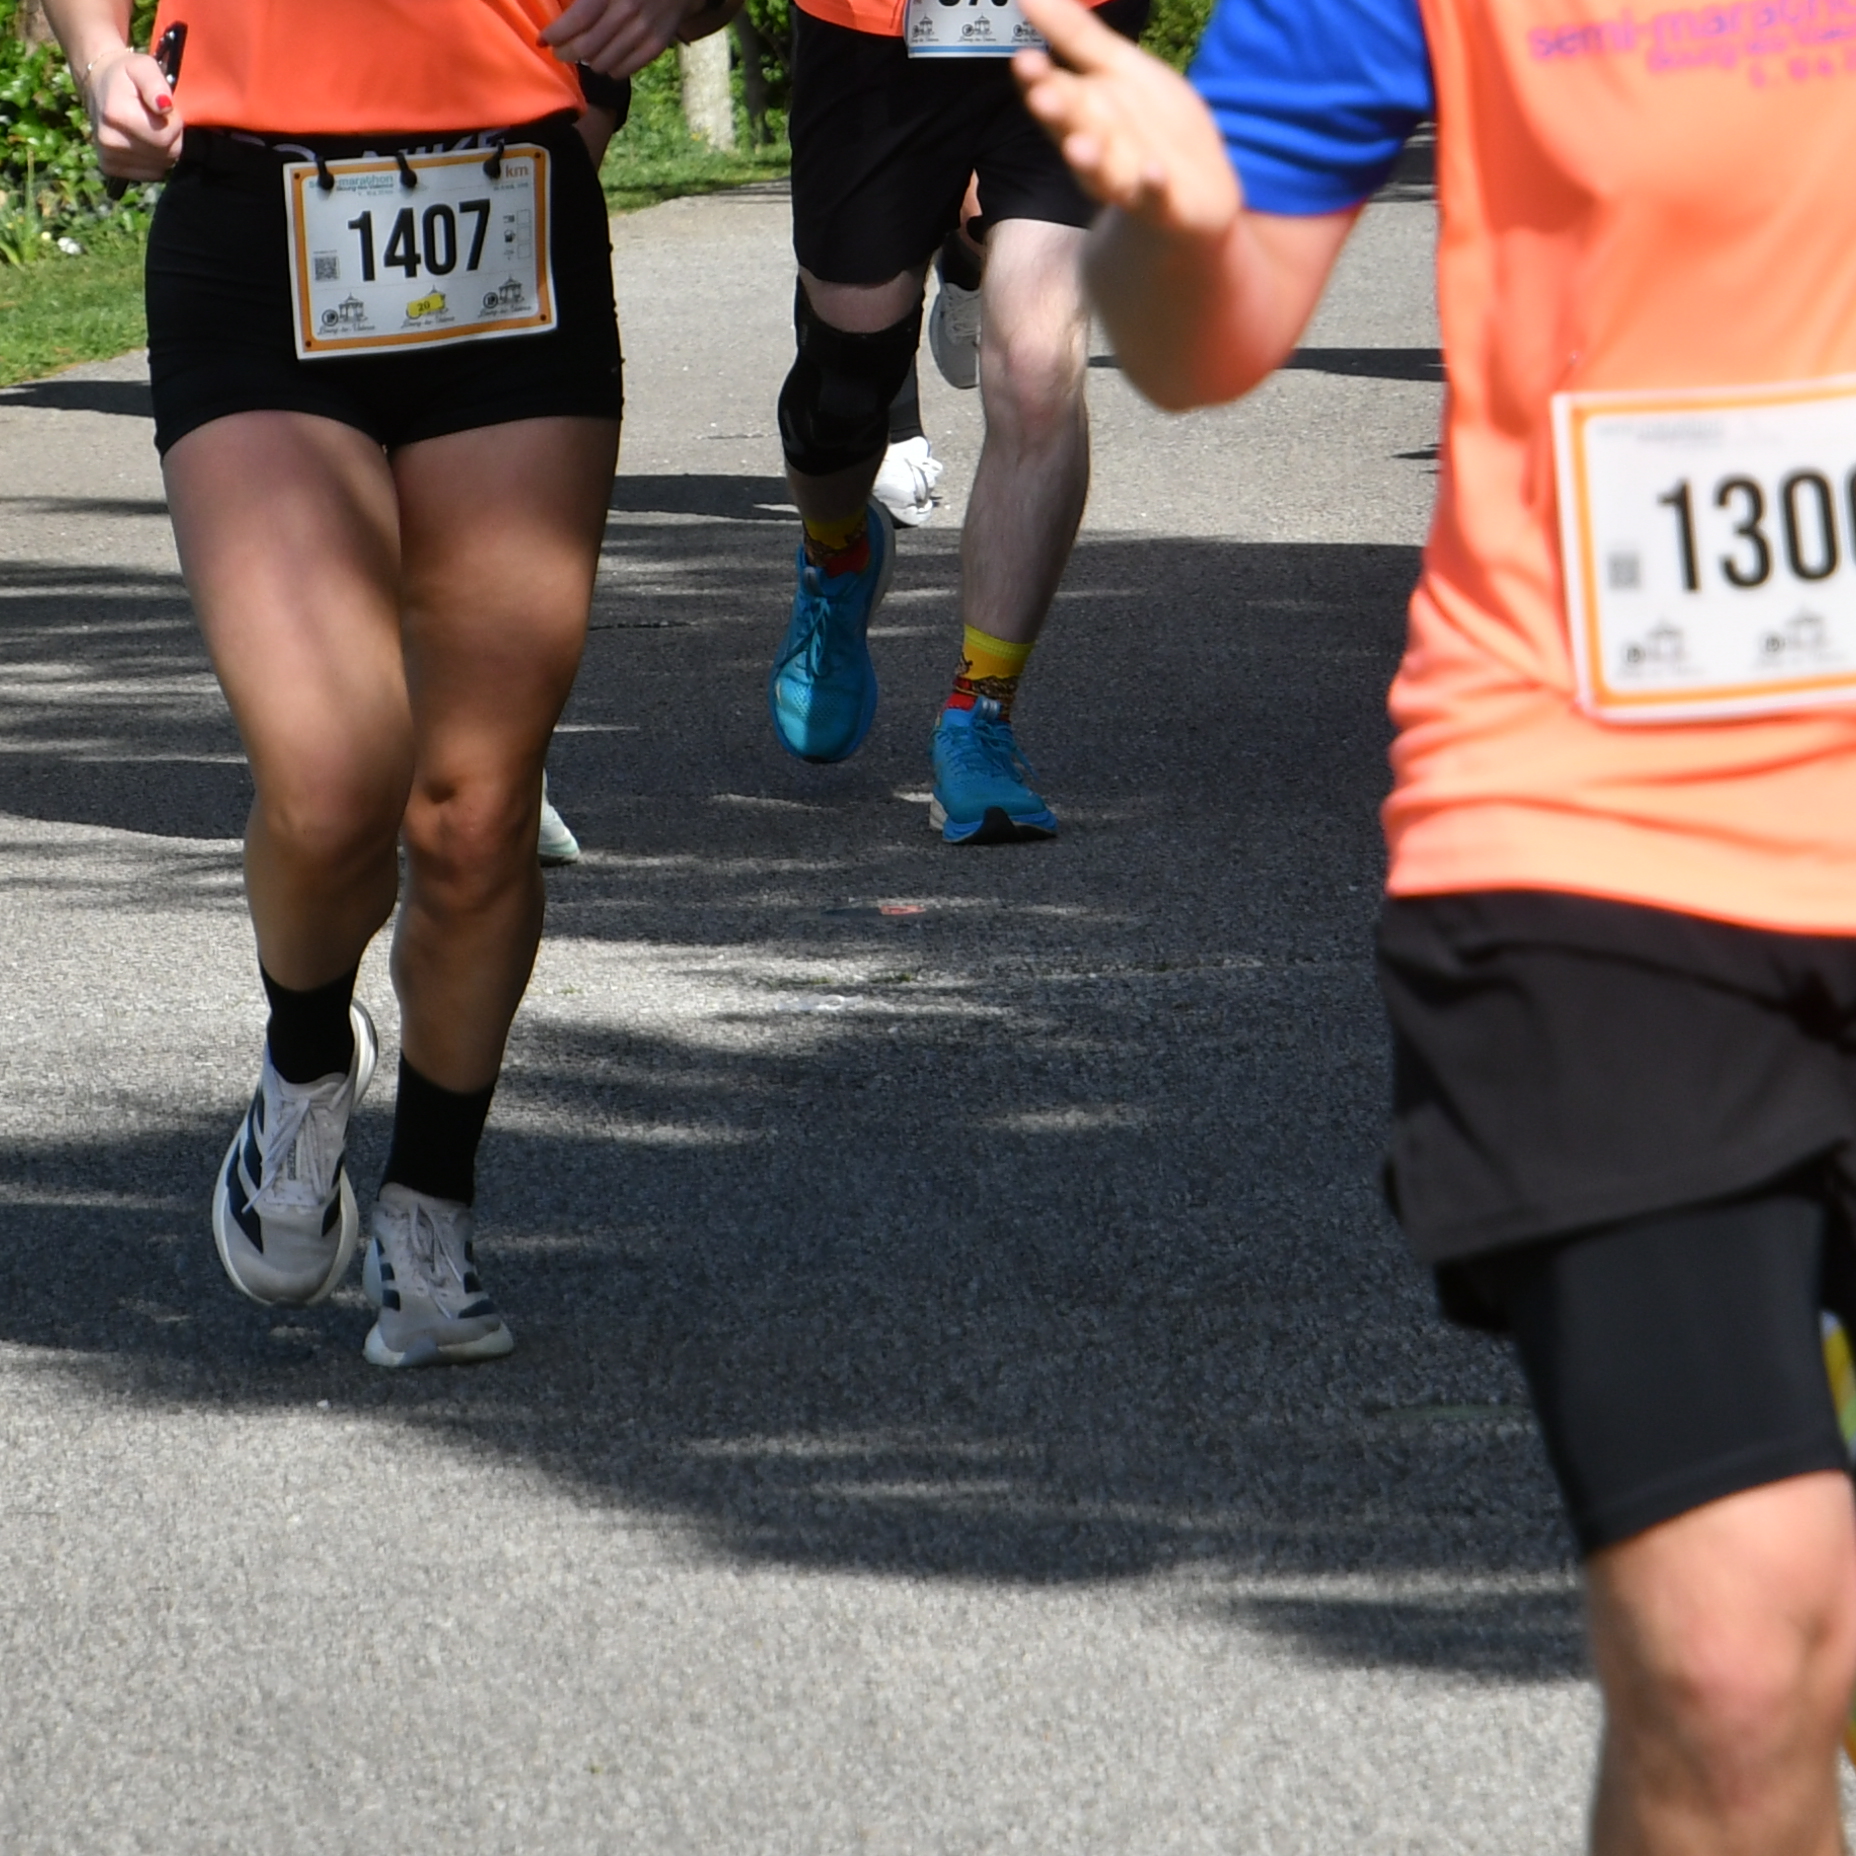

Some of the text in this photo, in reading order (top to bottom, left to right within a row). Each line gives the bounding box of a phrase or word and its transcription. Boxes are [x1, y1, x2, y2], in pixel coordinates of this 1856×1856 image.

[505, 164, 529, 178] km
[348, 198, 490, 282] 1407
[418, 300, 430, 311] 20
